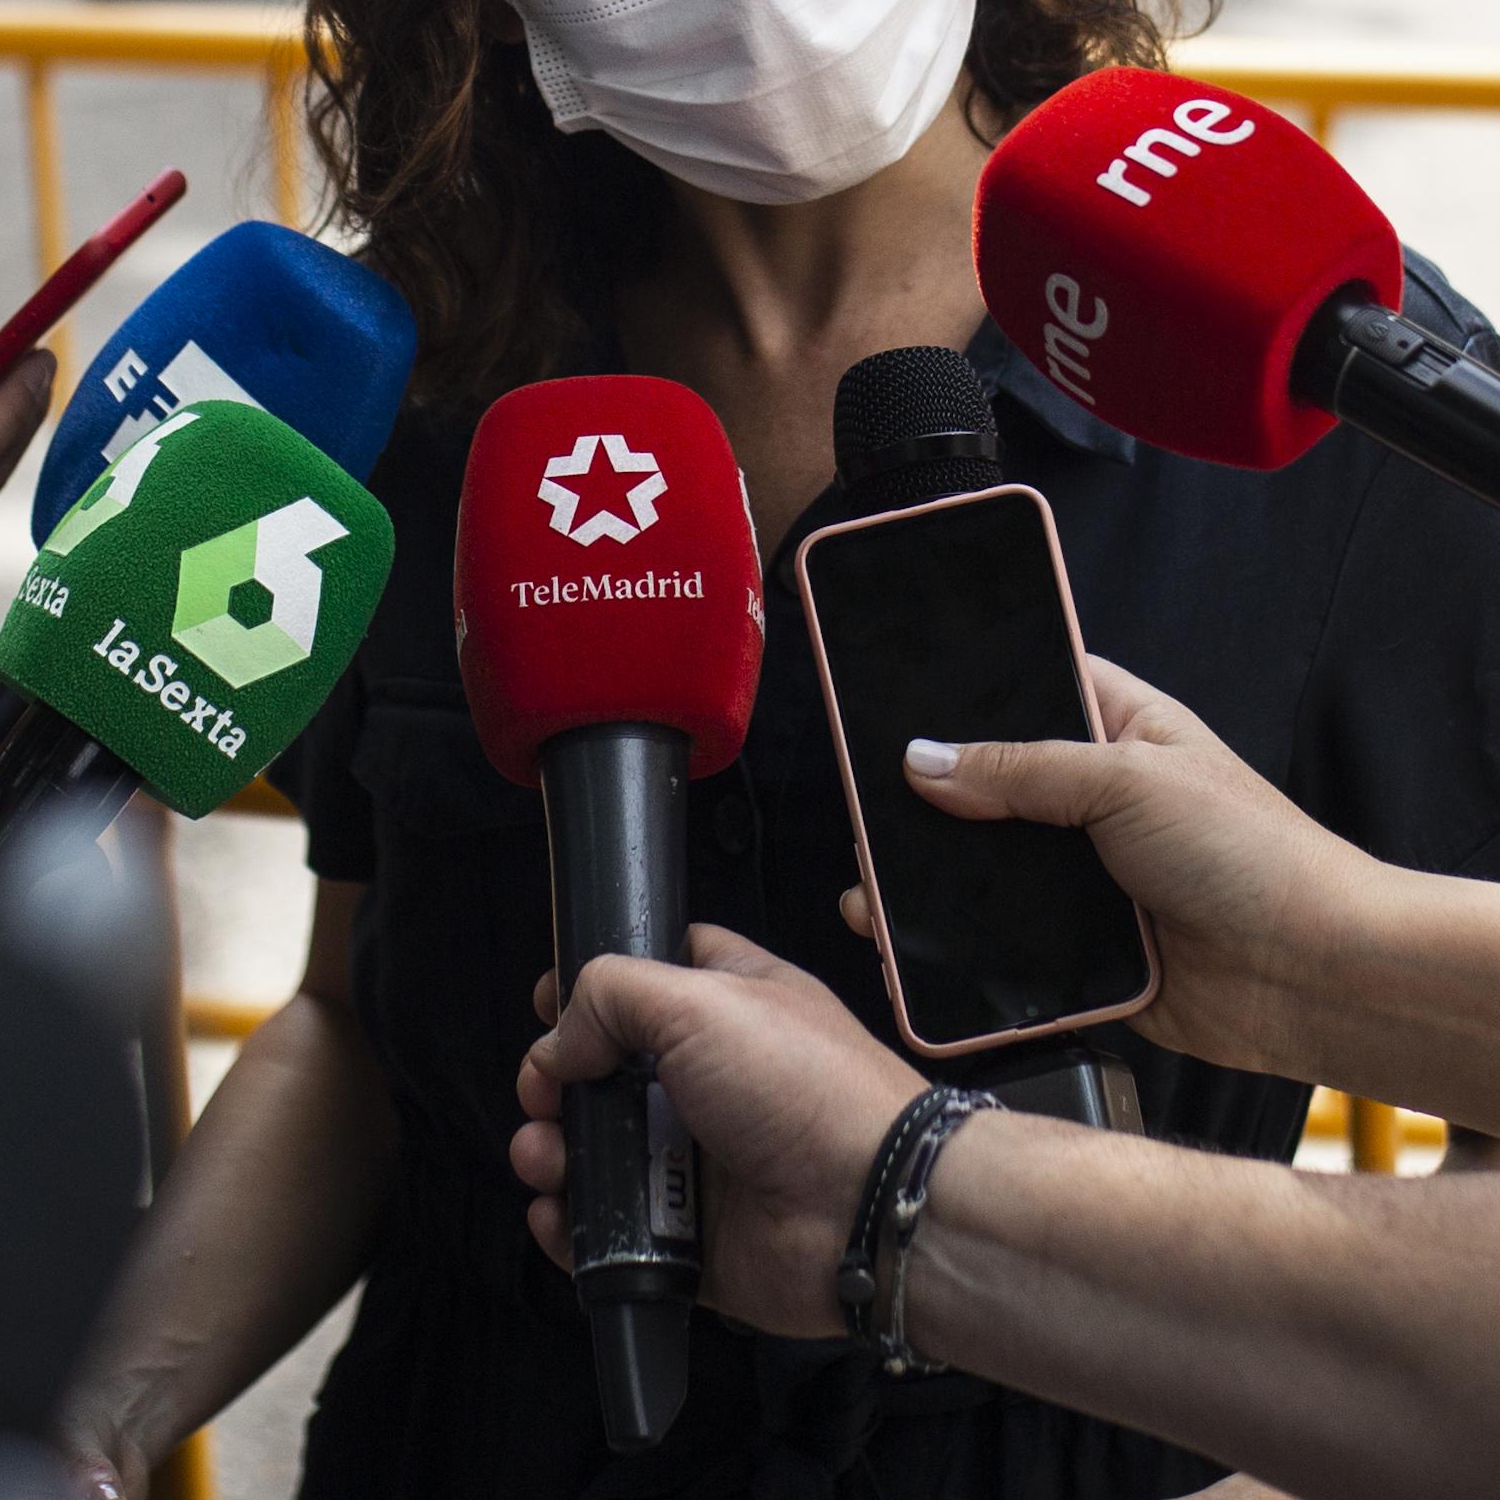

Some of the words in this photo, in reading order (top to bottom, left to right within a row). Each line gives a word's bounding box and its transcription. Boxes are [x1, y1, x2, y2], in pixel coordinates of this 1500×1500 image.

[1097, 99, 1256, 207] rne
[1043, 272, 1109, 406] rne
[510, 570, 705, 608] TeleMadrid
[93, 618, 247, 760] laSexta
